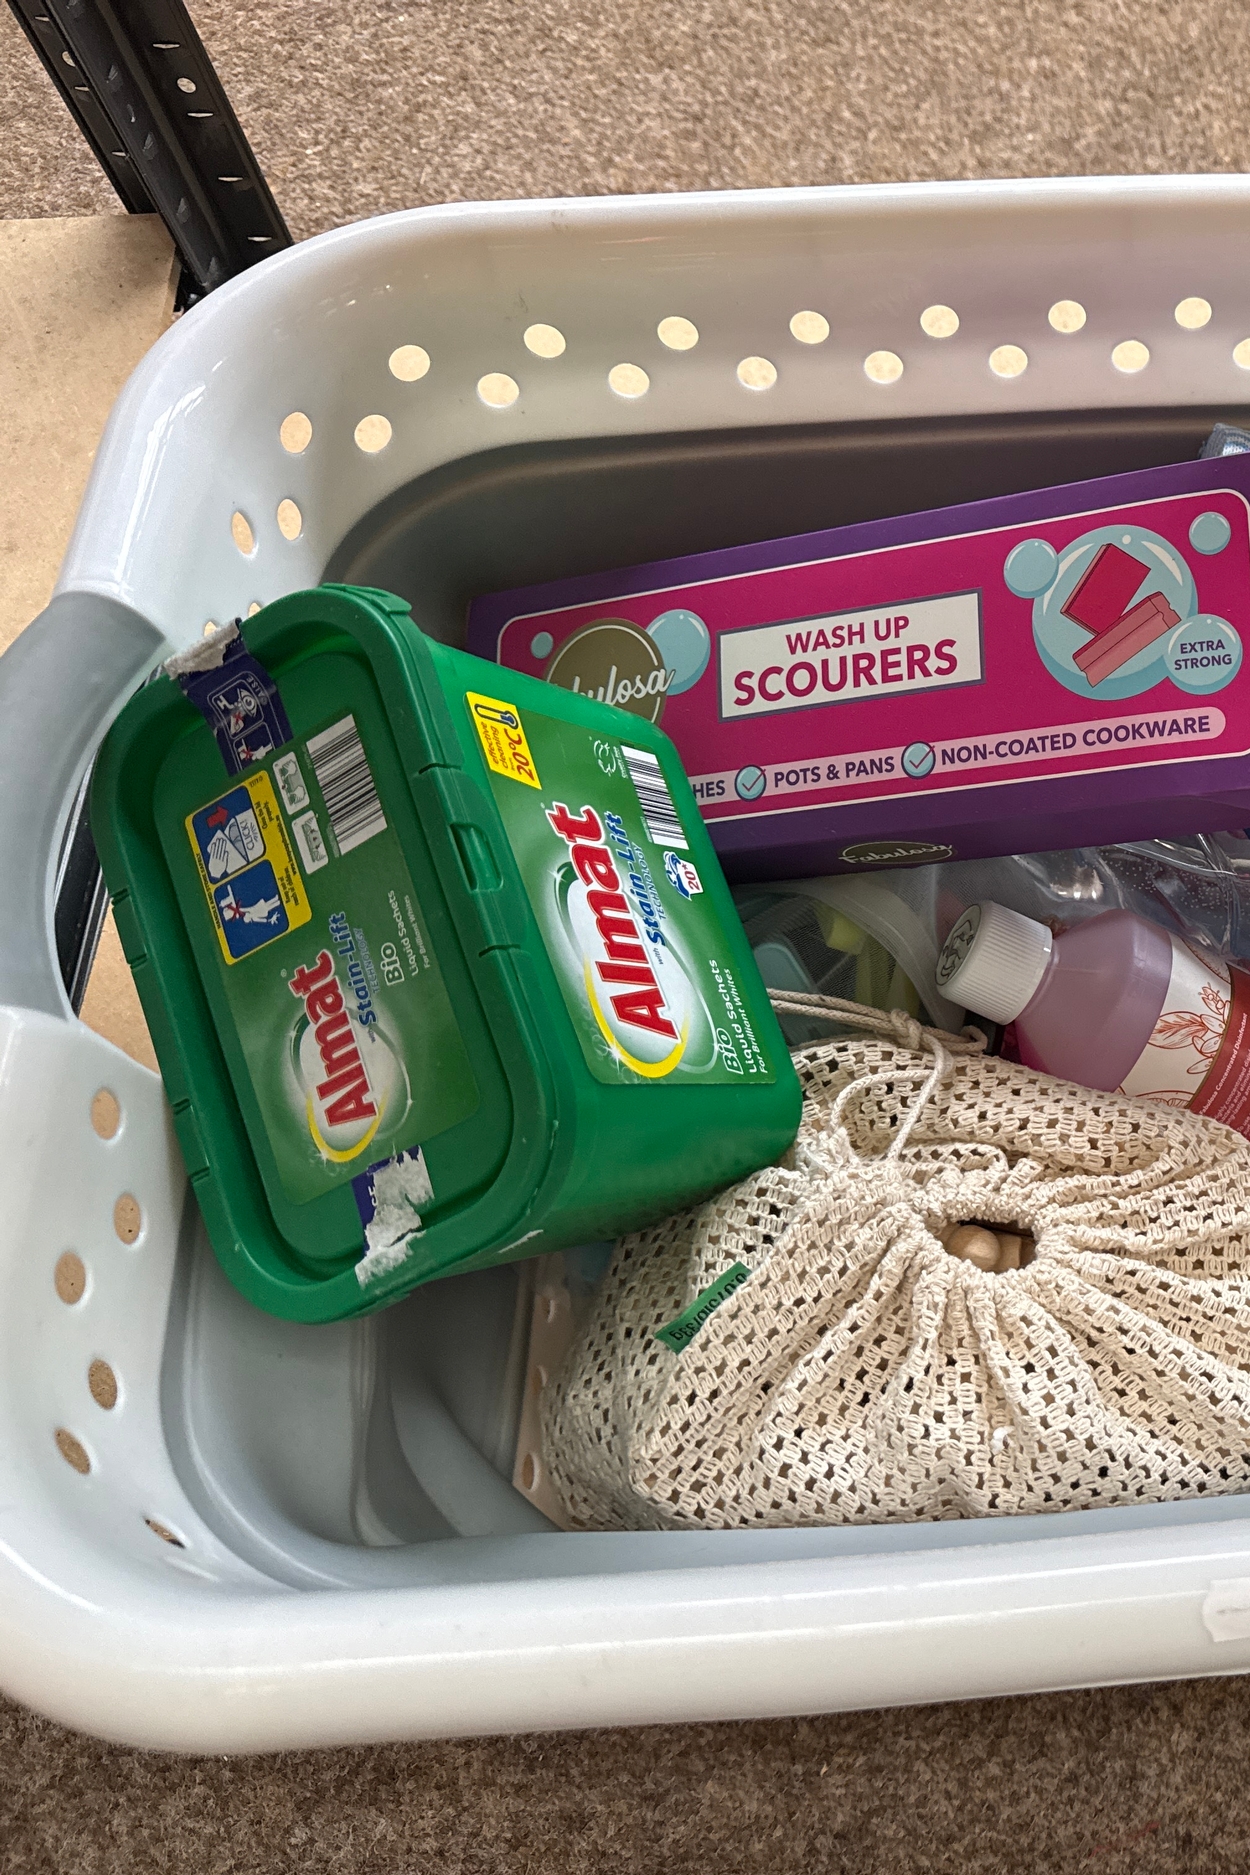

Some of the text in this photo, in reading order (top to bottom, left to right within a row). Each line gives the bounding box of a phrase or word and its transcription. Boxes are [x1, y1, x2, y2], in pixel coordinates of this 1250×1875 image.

[785, 615, 909, 655] WASH UP
[1174, 653, 1232, 670] STRONG
[1179, 639, 1225, 654] EXTRA
[733, 638, 958, 706] SCOURERS
[480, 721, 499, 764] effective
[489, 725, 508, 768] cleaning
[503, 727, 534, 780] 20°C
[692, 714, 1210, 799] HES POTS & PANS NON-COATED COOKWARE
[238, 818, 256, 851] CLICK!
[838, 844, 952, 864] Fabulosa
[195, 851, 222, 929] HANDLE AND STORE SAFELY
[603, 812, 666, 964] with Stain-Lift
[632, 843, 666, 919] TECHNOLOGY
[386, 889, 419, 976] Liquid Sachets
[403, 894, 431, 968] For Brilliant Whites
[547, 804, 678, 1039] Almat
[330, 911, 377, 1043] with Stain-Lift
[353, 926, 381, 993] TECHNOLOGY
[379, 943, 404, 985] Bio
[289, 951, 376, 1126] Almat
[709, 959, 757, 1072] Liquid Sachets
[715, 1028, 744, 1073] Bio
[722, 968, 768, 1072] For Brilliant Whites
[1202, 1011, 1248, 1113] abulosa Concentrated Disinfectant
